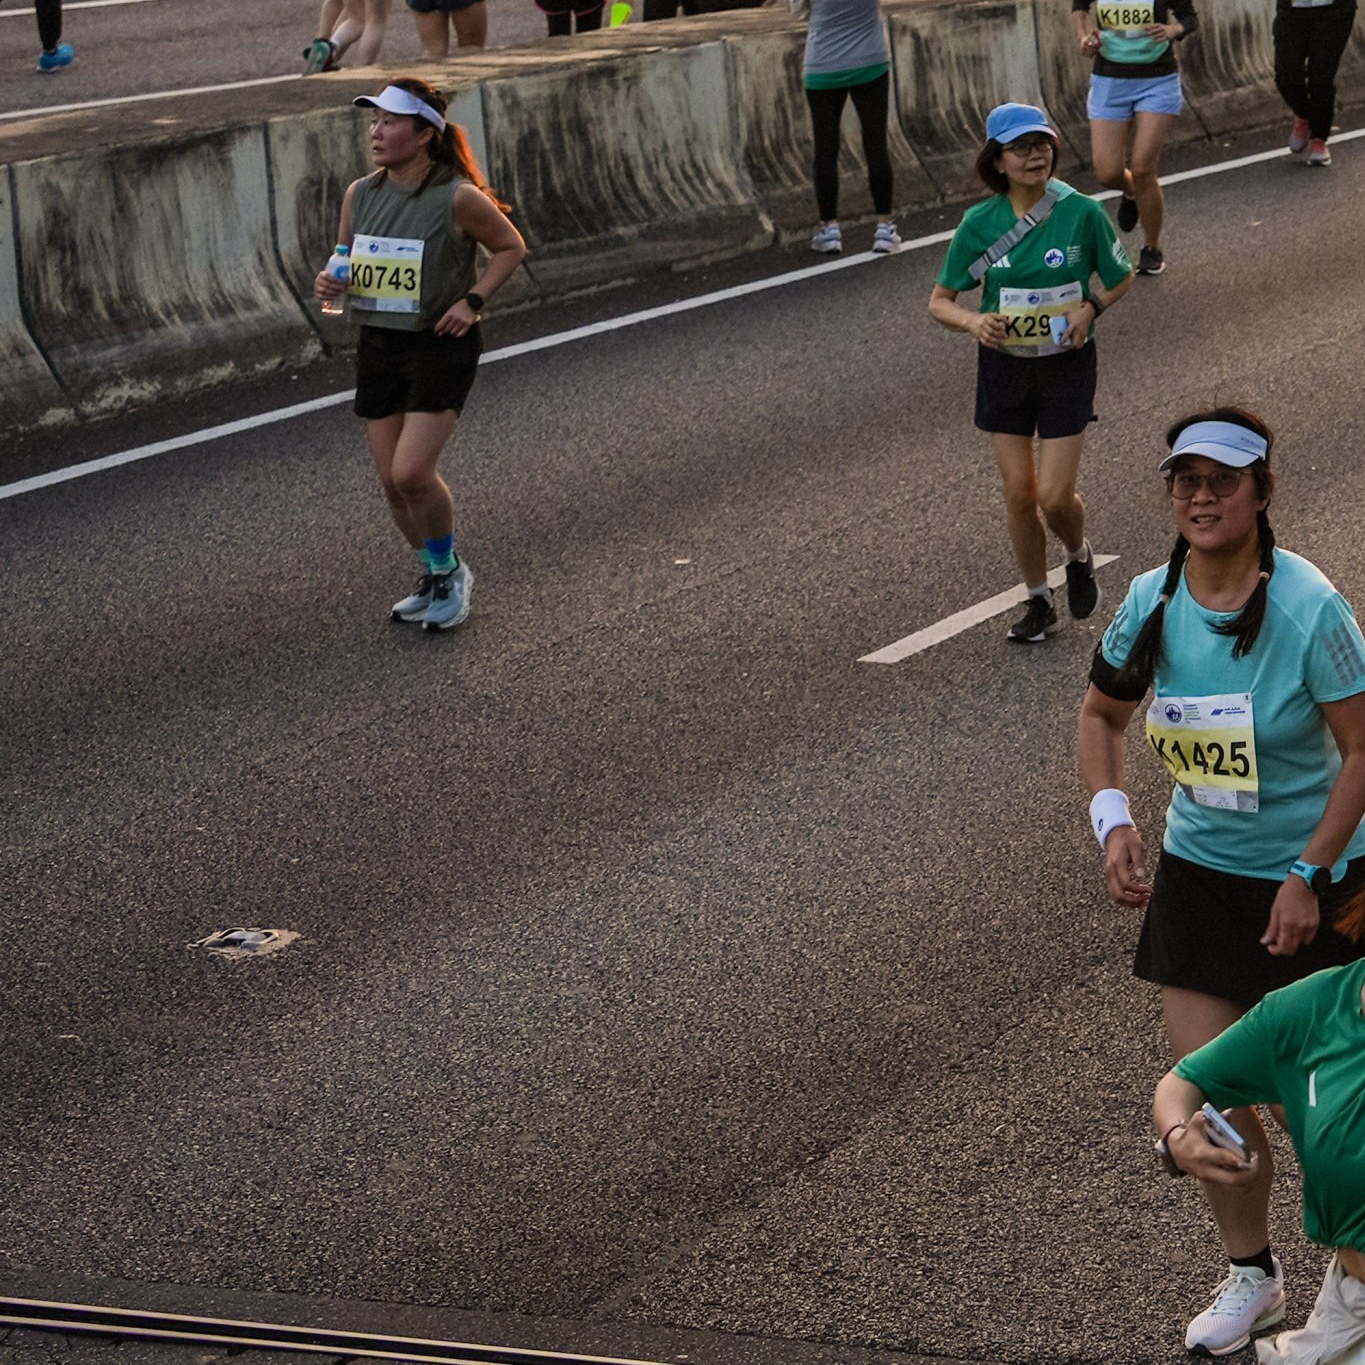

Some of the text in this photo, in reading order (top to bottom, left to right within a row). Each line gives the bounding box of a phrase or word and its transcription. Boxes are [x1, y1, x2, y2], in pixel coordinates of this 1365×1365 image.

[1101, 8, 1152, 26] K1882
[351, 264, 417, 292] K0743
[1006, 314, 1053, 339] K29
[1150, 734, 1250, 778] K1425
